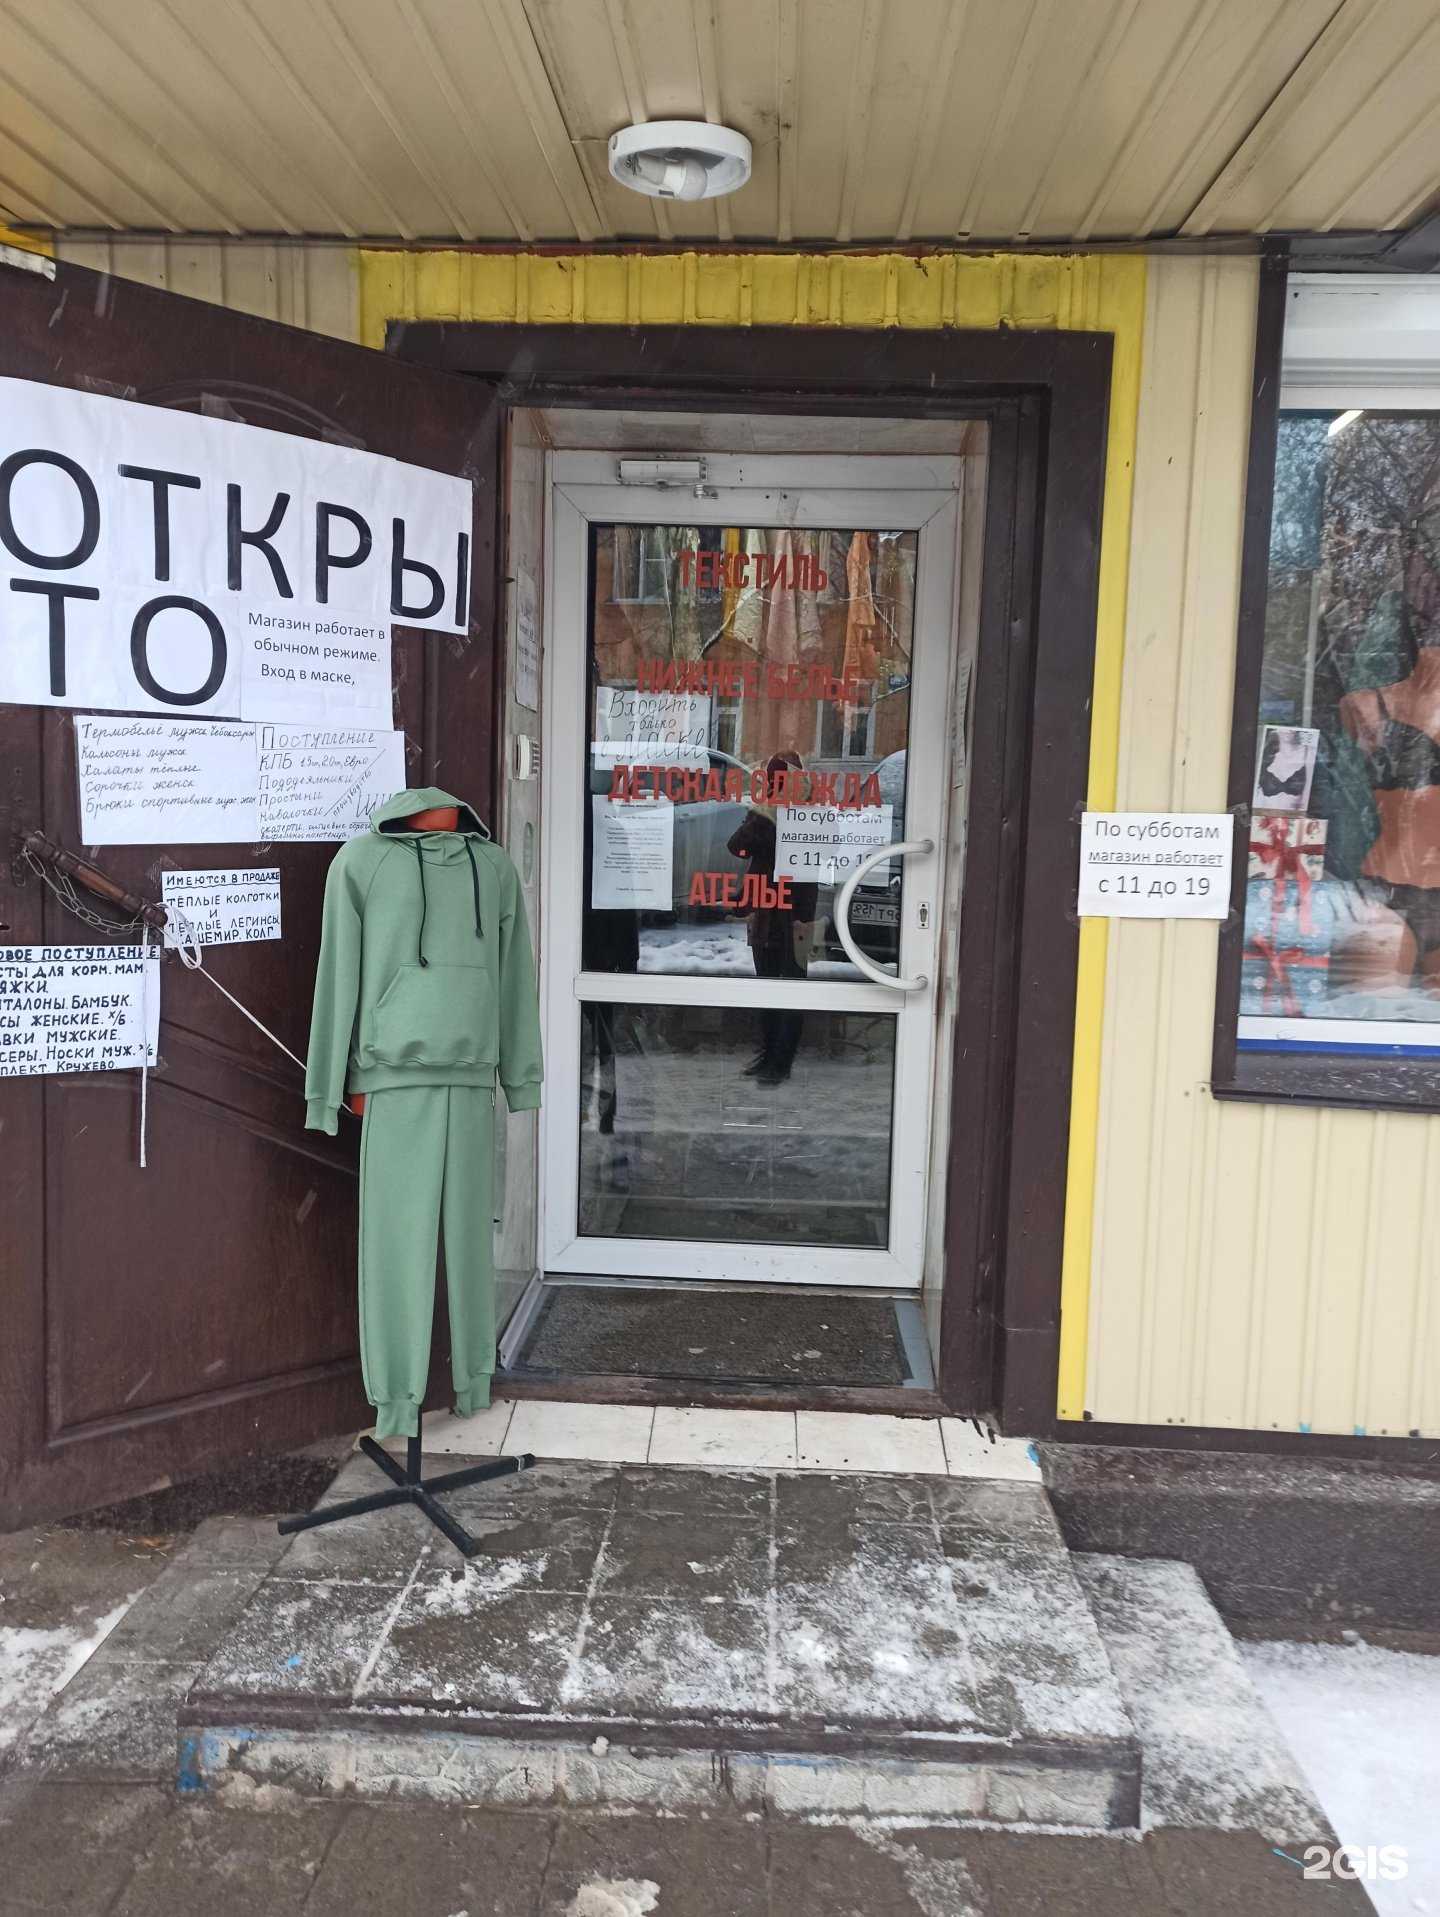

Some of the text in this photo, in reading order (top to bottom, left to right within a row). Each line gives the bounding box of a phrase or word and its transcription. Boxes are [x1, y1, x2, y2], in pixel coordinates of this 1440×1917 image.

[0, 448, 469, 626] ОТКРЫ
[677, 550, 828, 592] ТЕКСТИЛЬ
[248, 611, 386, 640] Магазин работает в
[9, 577, 228, 707] ТО
[254, 637, 319, 656] обычном
[261, 663, 355, 687] Вход в маске,
[638, 659, 861, 701] НИЖНЕЕ БЕЛЬЕ
[608, 690, 697, 719] Входить
[628, 715, 677, 731] только
[261, 726, 375, 749] Поступление
[259, 752, 293, 772] КПБ
[608, 765, 882, 810] ДЕТСКАЯ ОДЕЖДА
[86, 798, 135, 818] Брюки
[787, 807, 883, 826] По субботам
[781, 832, 886, 845] магазин работает
[1095, 820, 1220, 841] По субботам
[789, 853, 798, 866] с
[803, 851, 822, 867] 11
[827, 856, 850, 870] до
[1088, 850, 1224, 866] магазин работает
[231, 873, 238, 884] В
[242, 871, 280, 882] ПРОДАЖЕ
[1098, 875, 1211, 899] с 11 до 19
[226, 892, 280, 904] КОЛГОТКИ
[688, 873, 794, 910] АТЕЛЬЕ
[209, 909, 218, 919] И
[230, 915, 280, 929] ЛЕГИНСЫ
[32, 966, 64, 979] ДЛЯ
[0, 1032, 35, 1046] ВКИ
